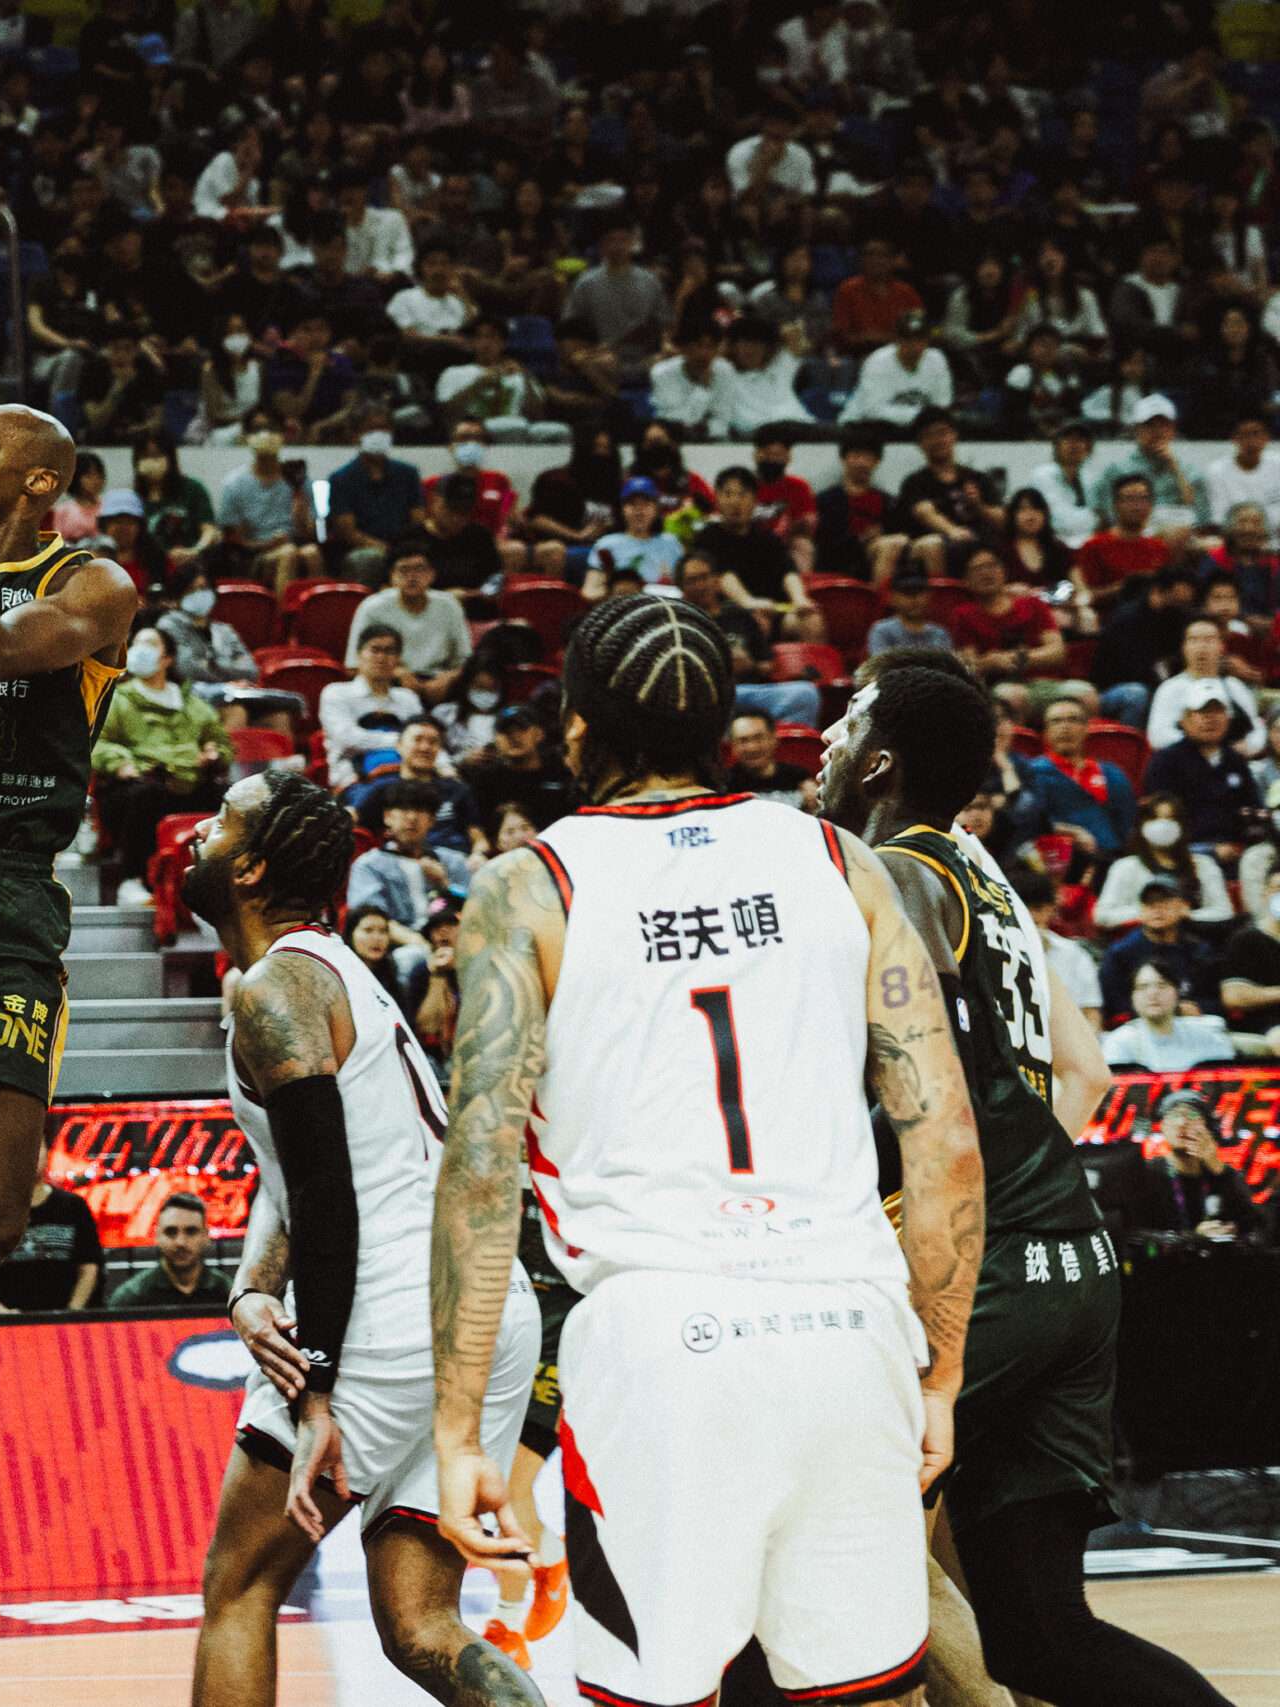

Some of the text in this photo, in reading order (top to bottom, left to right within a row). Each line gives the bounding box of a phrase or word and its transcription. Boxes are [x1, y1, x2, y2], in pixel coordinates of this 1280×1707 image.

[638, 893, 784, 963] 洛夫頓
[3, 994, 49, 1025] 金牌
[689, 984, 755, 1175] 1
